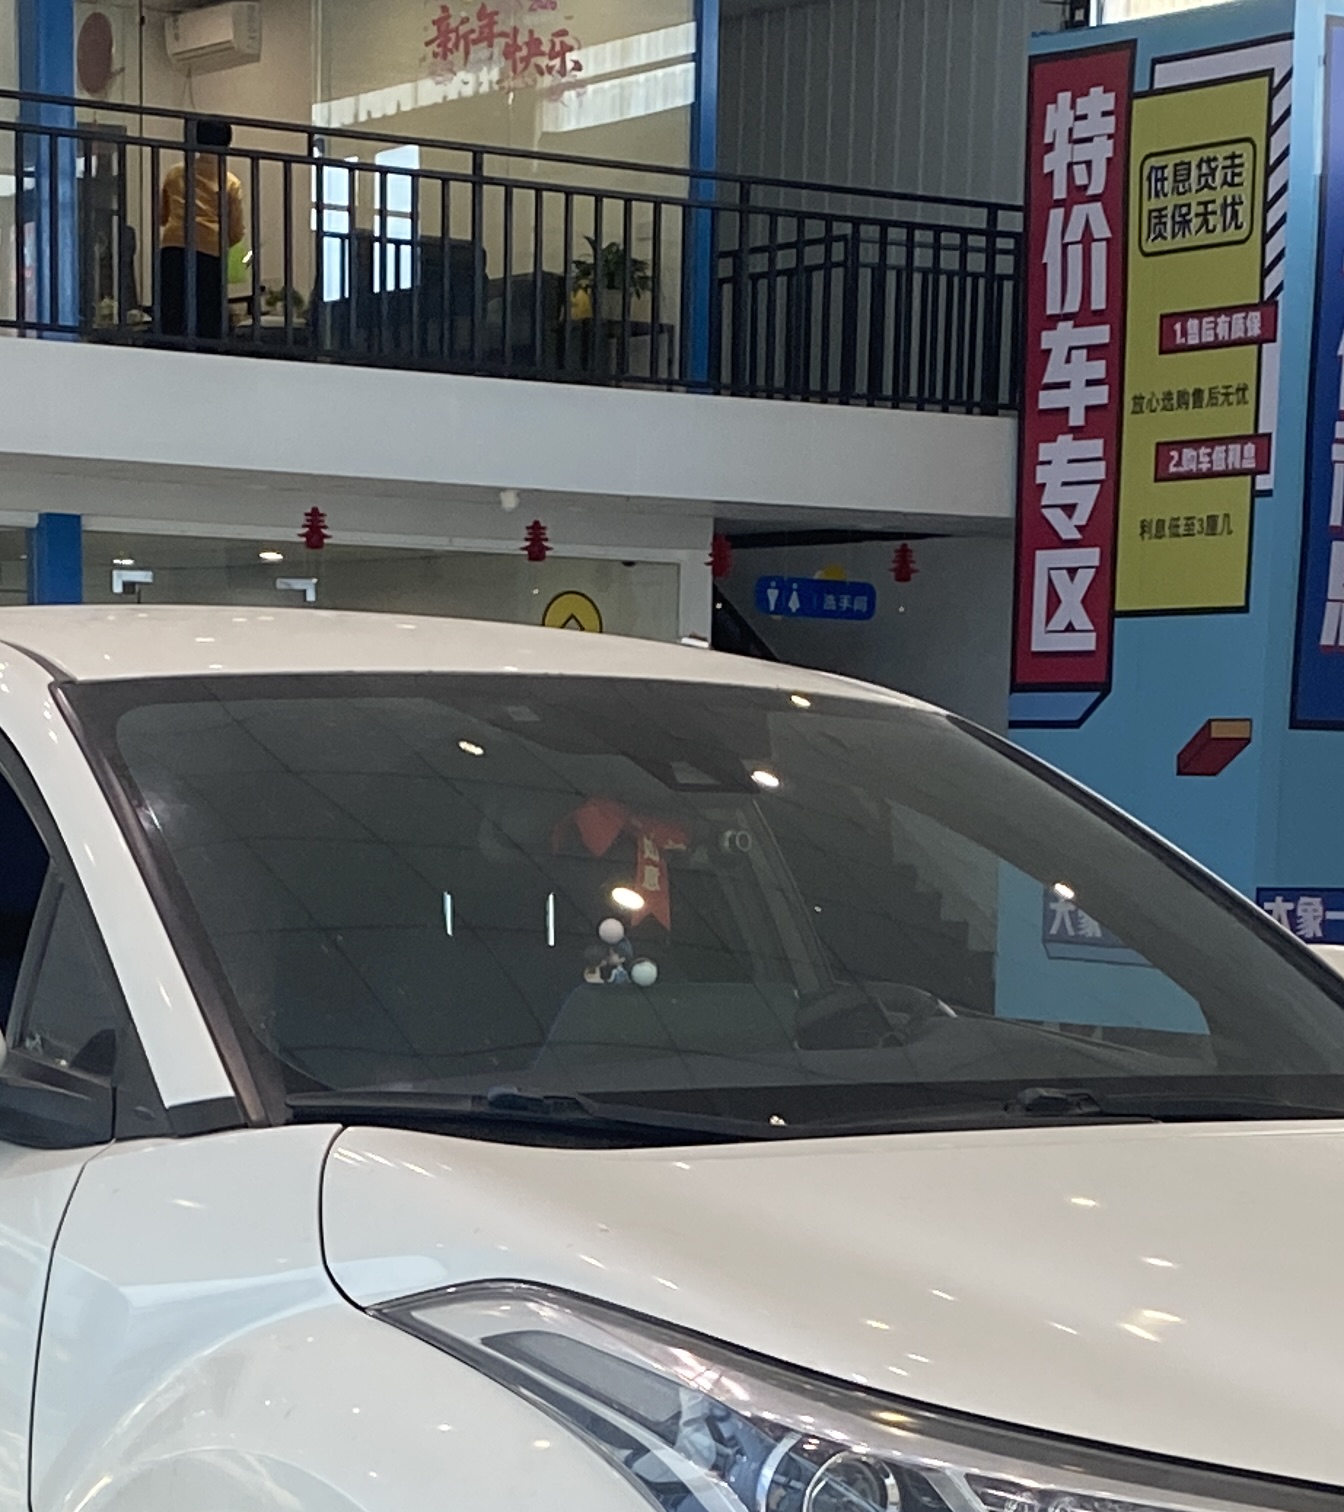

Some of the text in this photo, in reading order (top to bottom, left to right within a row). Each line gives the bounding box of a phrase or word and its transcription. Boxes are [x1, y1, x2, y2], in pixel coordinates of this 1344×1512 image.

[424, 3, 583, 78] 新年快乐
[1146, 151, 1245, 201] 低息贷走
[1146, 194, 1245, 244] 质保无忧
[1173, 311, 1262, 345] 1.售后有质保
[1030, 86, 1116, 653] 特价车专区
[1130, 382, 1249, 415] 放心选购售后无忧
